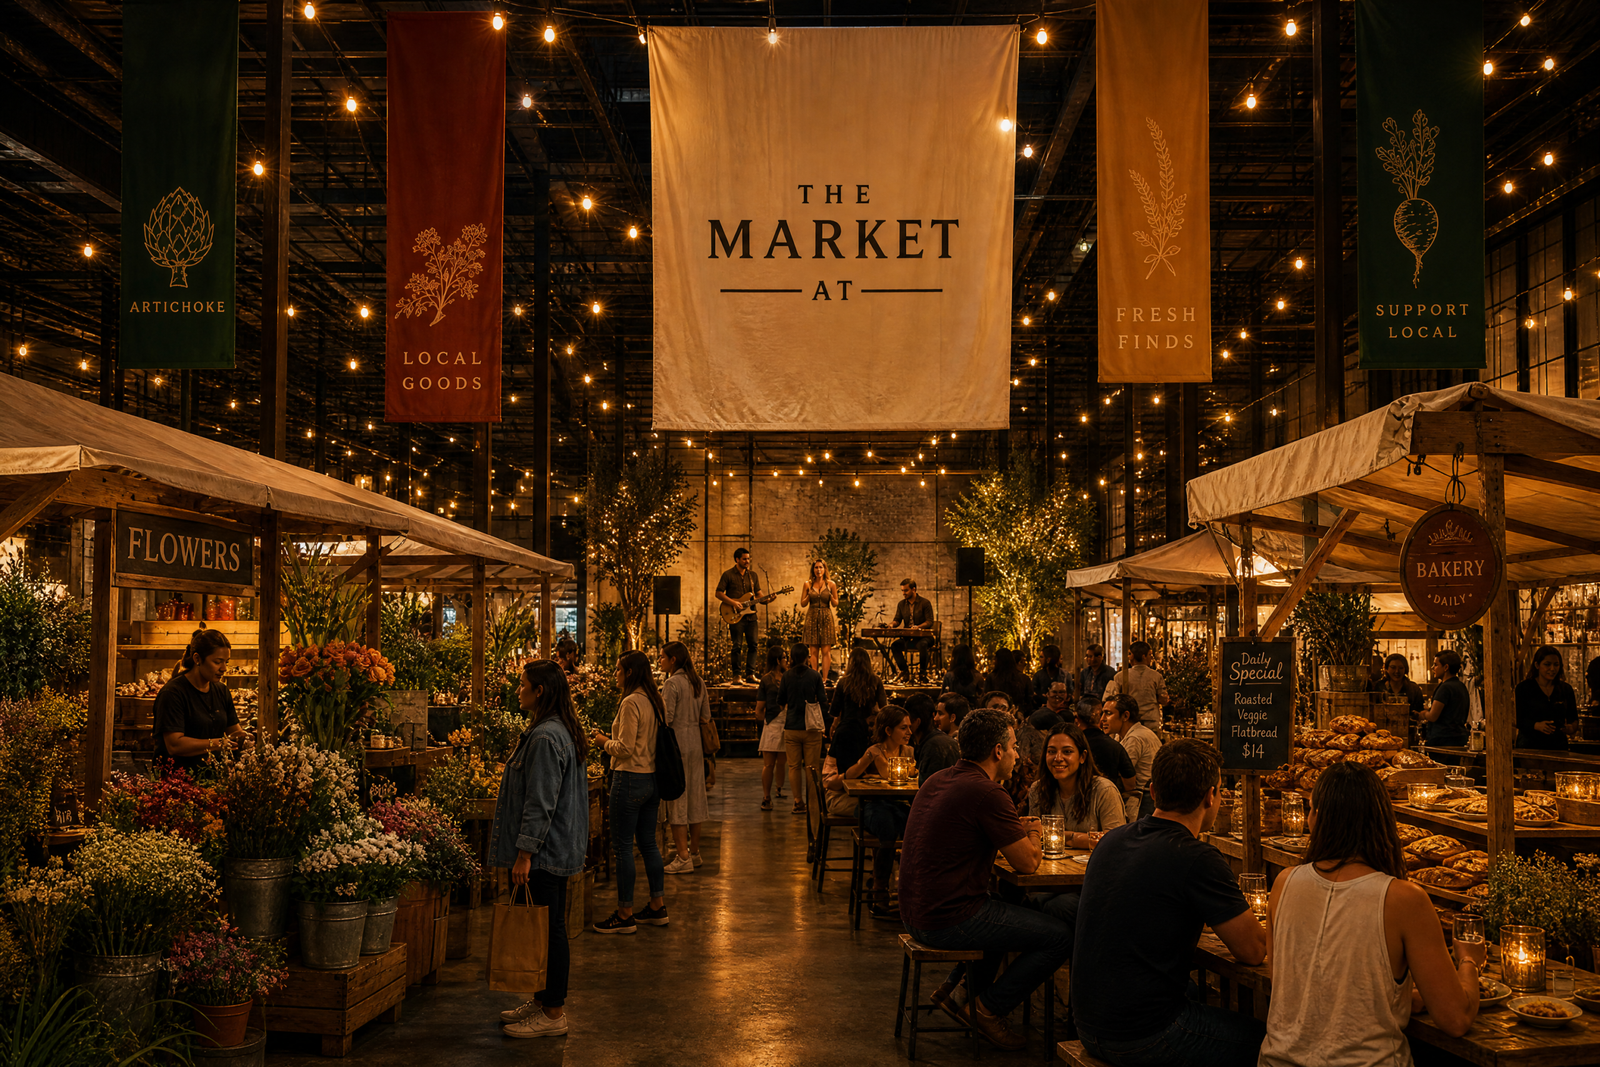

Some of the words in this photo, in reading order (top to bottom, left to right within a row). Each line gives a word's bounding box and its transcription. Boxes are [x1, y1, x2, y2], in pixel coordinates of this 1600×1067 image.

[798, 185, 870, 204] THE
[708, 219, 960, 259] MARKET
[812, 280, 852, 300] AT
[129, 301, 225, 313] ARTICHOKE
[1116, 307, 1196, 322] FRESH
[1375, 303, 1469, 317] SUPPORT
[1388, 326, 1457, 339] LOCAL
[1118, 334, 1194, 349] FINDS
[403, 351, 482, 365] LOCAL
[402, 376, 482, 390] GOODS
[127, 526, 240, 572] FLOWERS
[1416, 560, 1485, 578] BAKERY
[1433, 593, 1466, 606] DAILY
[1241, 652, 1271, 669] Daily
[1229, 661, 1284, 686] Special
[1234, 692, 1273, 705] Roasted
[1237, 708, 1268, 725] Veggie
[1231, 725, 1278, 738] Flatbread
[1242, 742, 1265, 759] $14
